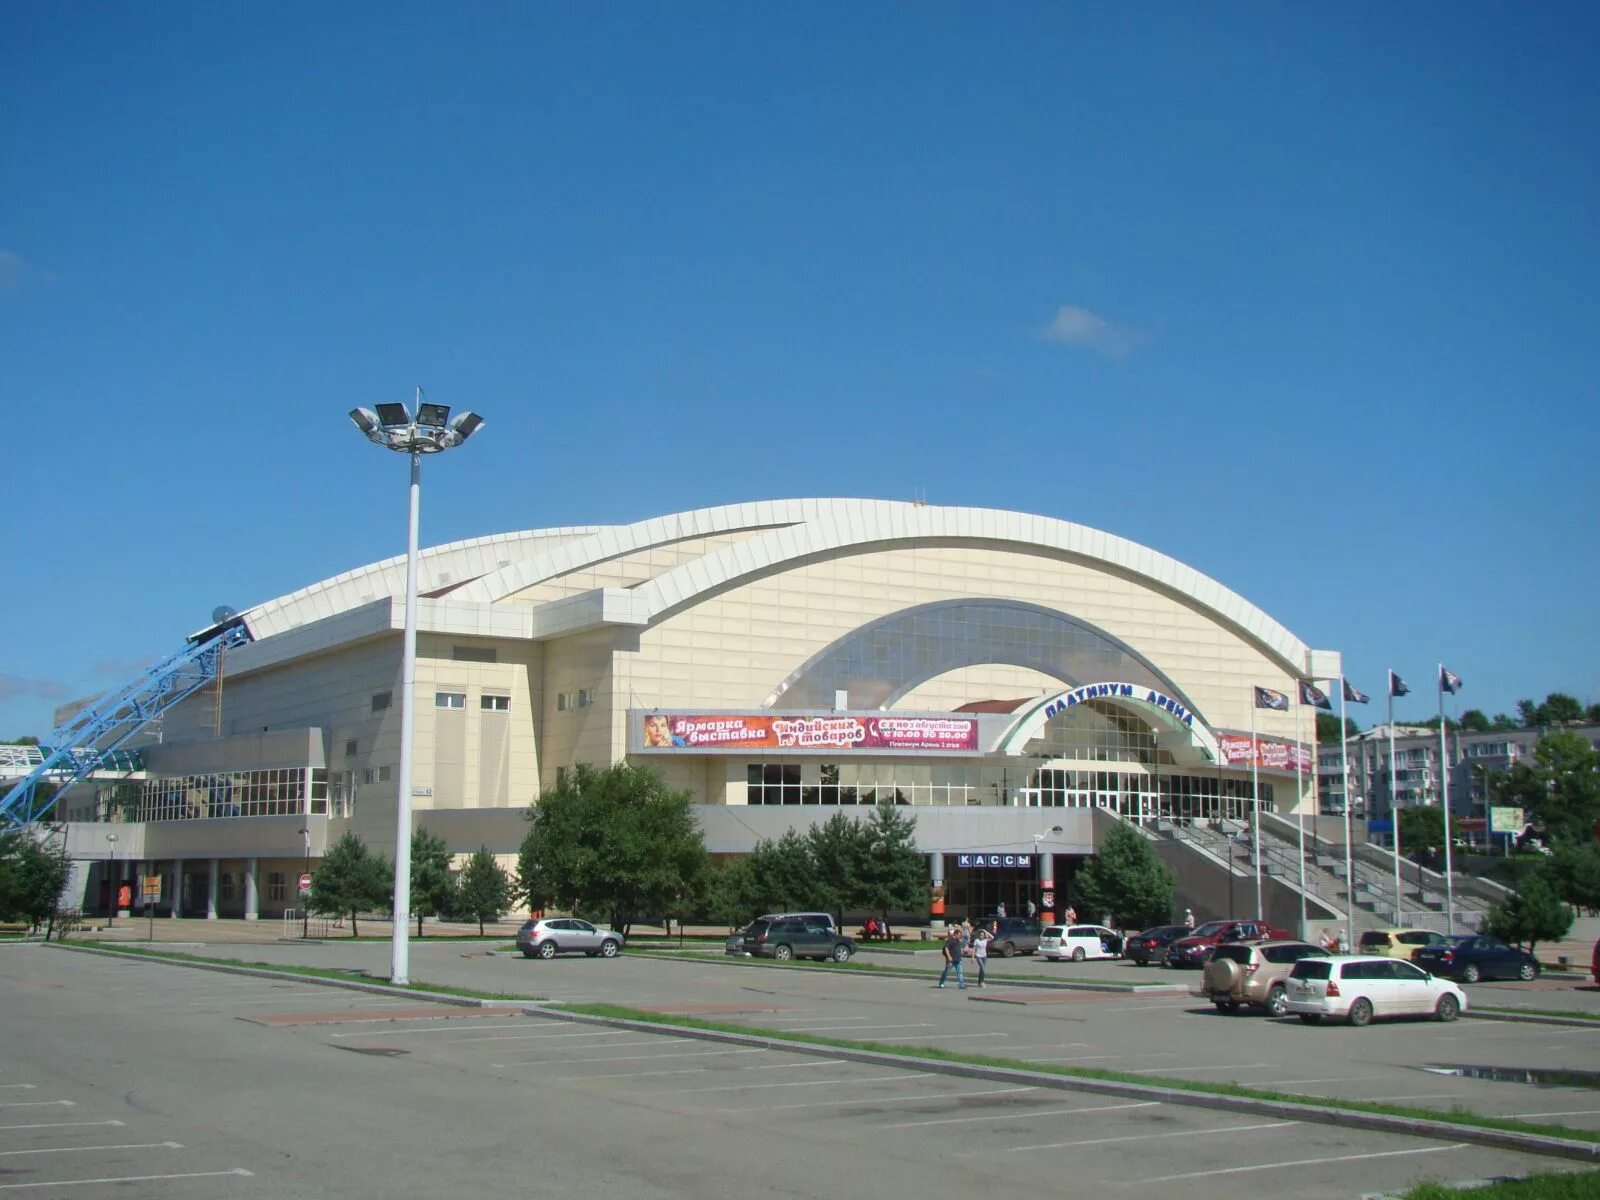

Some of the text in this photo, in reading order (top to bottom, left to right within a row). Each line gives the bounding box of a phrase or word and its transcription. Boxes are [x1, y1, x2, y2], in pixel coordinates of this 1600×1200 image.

[1044, 683, 1193, 726] ПЛАТИНУМ АРЕНА
[675, 720, 743, 734] Ярмарка
[775, 719, 855, 734] Индийских
[690, 728, 765, 743] выставка
[801, 728, 862, 743] товаров
[961, 855, 1029, 865] КАССЫ
